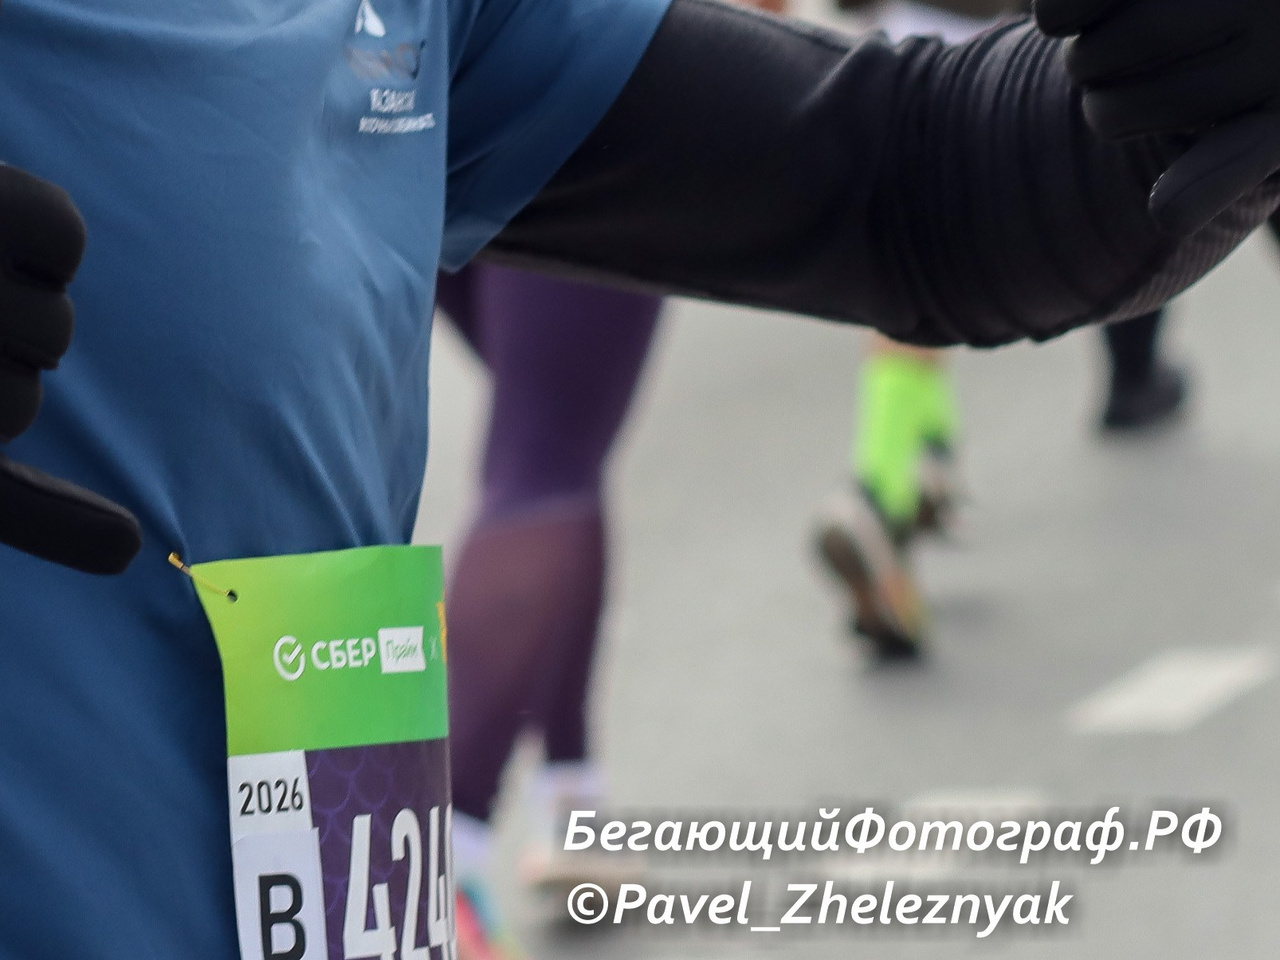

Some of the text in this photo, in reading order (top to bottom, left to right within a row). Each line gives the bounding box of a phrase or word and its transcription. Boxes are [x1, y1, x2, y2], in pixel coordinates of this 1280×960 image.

[310, 637, 377, 671] СБЕР
[237, 776, 304, 817] 2026
[342, 803, 458, 960] 424
